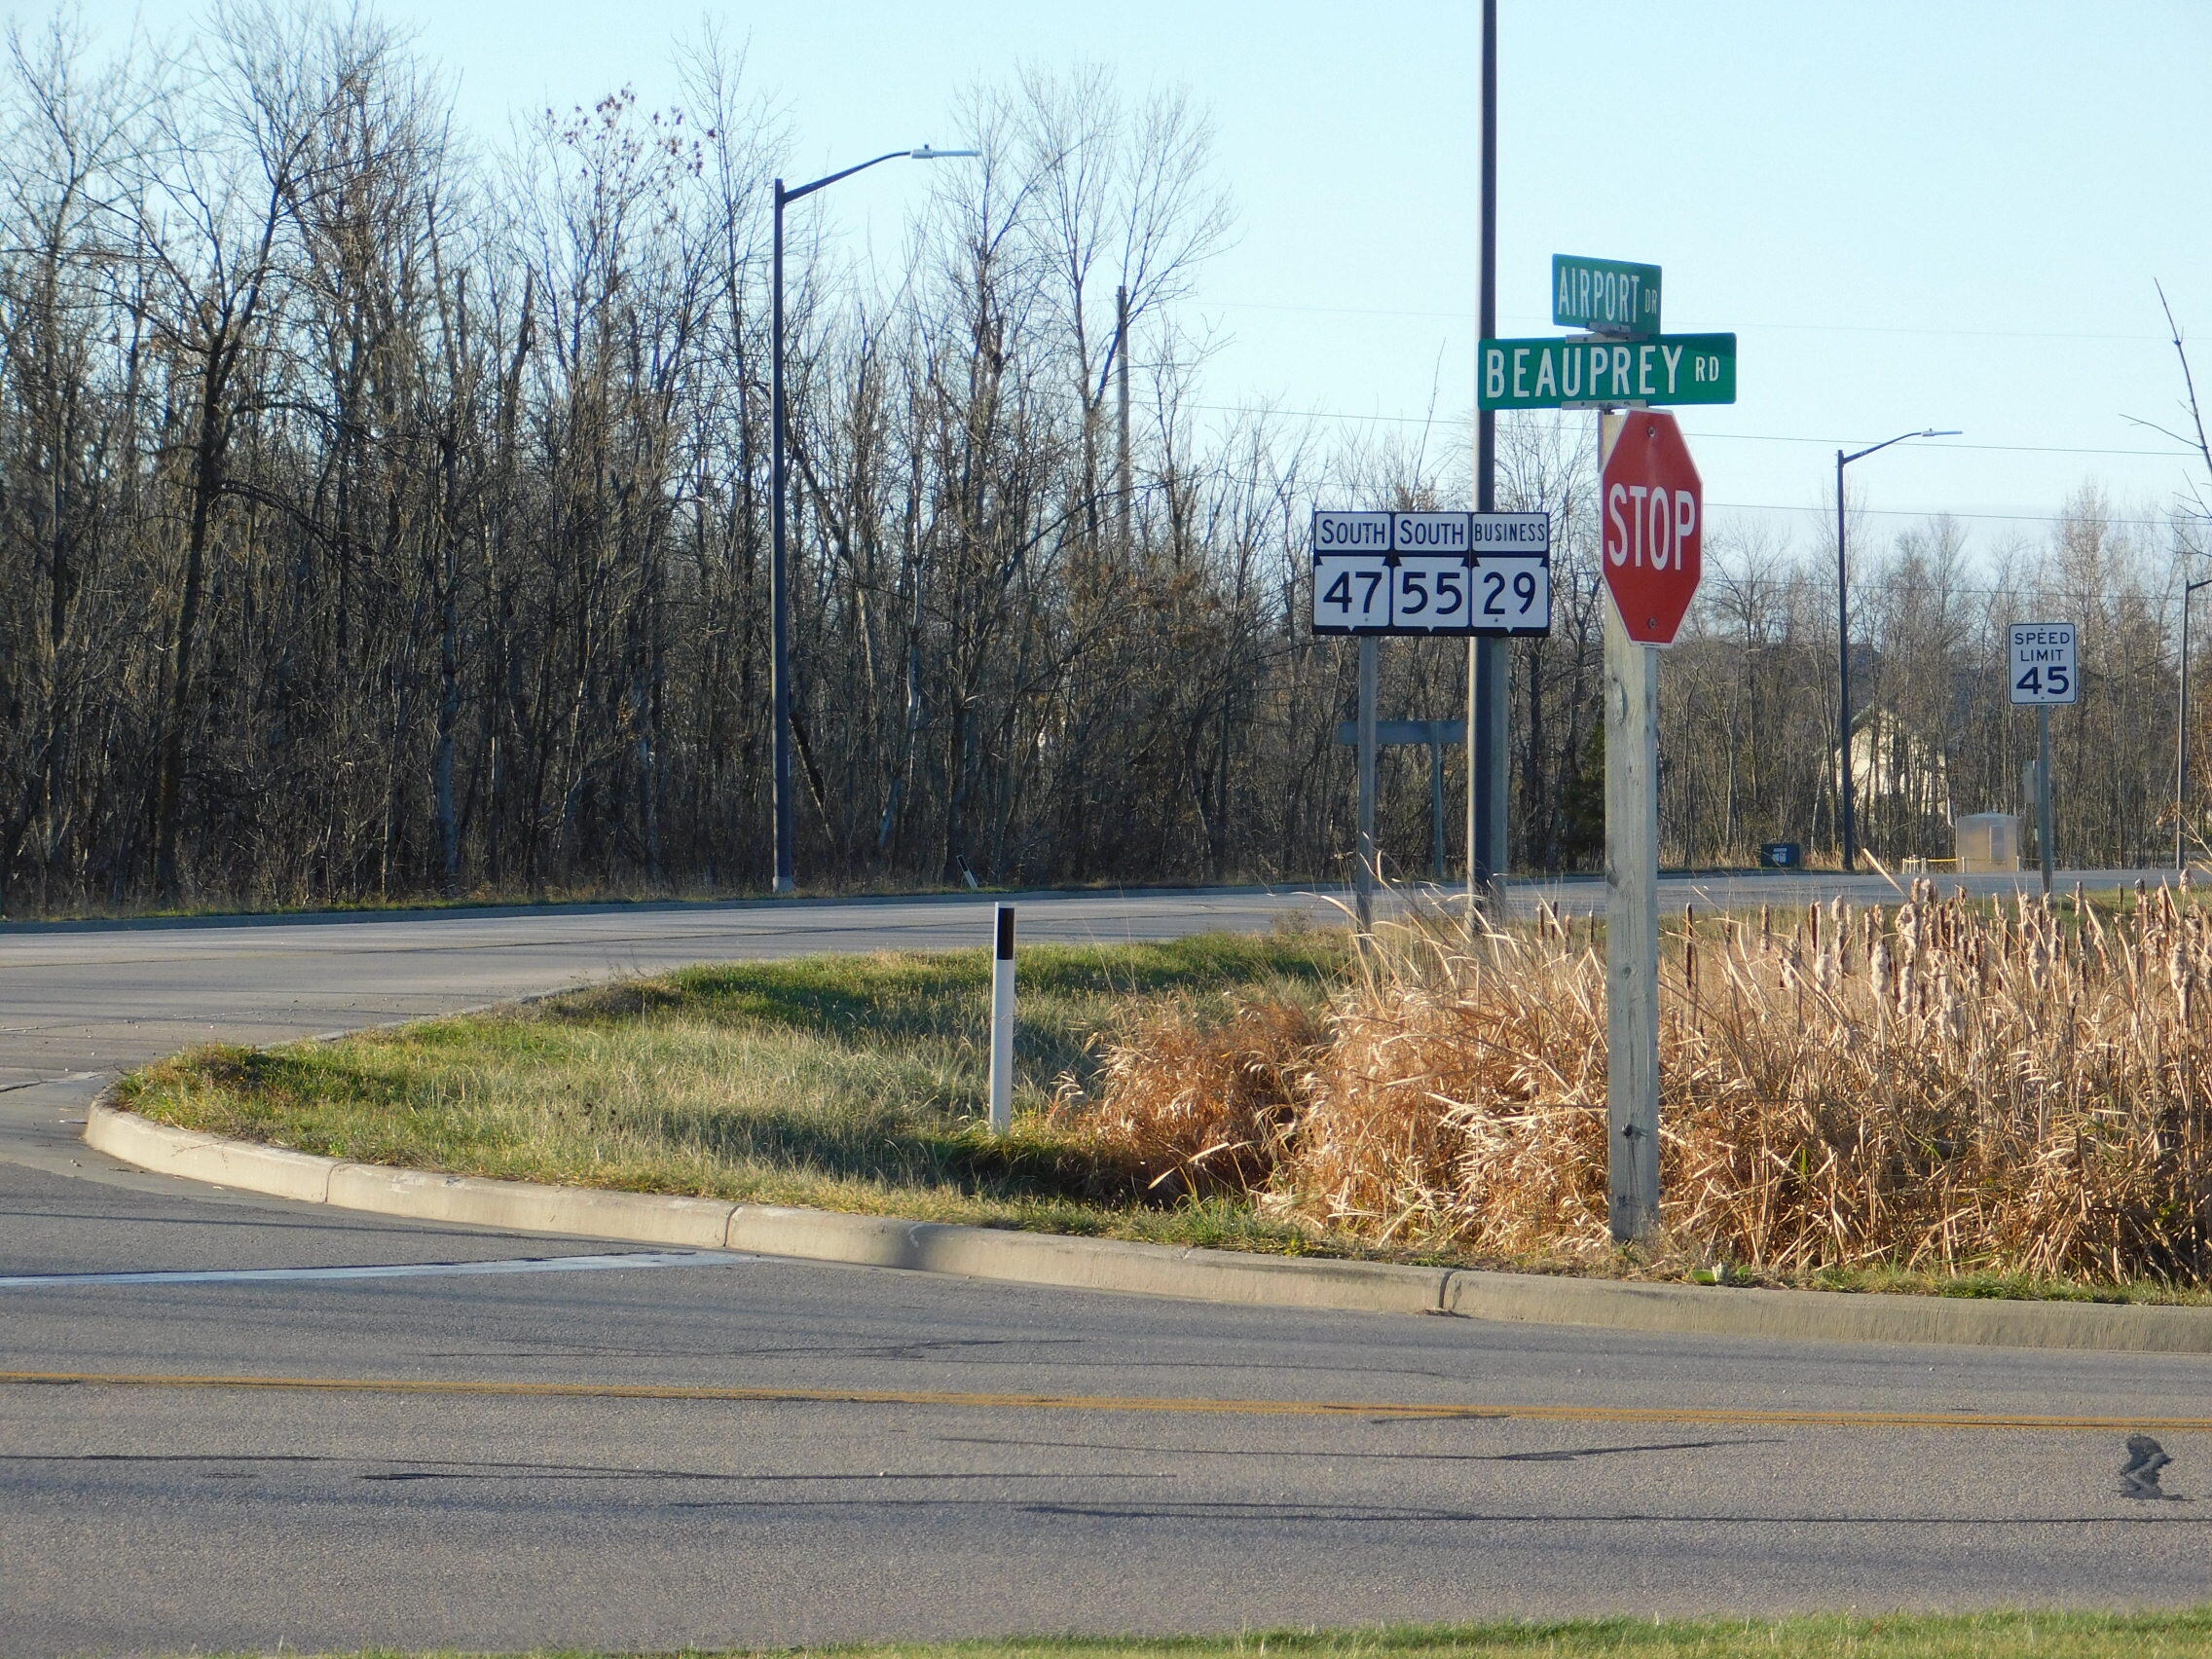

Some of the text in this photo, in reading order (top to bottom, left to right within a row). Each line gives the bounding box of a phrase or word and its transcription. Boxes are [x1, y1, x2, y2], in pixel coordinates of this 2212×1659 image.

[1558, 266, 1657, 323] AIRPORT DR
[1486, 345, 1719, 398] BEAUPREY RD
[1321, 519, 1385, 544] SOUTH
[1400, 519, 1464, 545] SOUTH
[1474, 523, 1545, 541] BUSINESS
[1608, 483, 1695, 571] STOP
[1323, 571, 1382, 613] 47
[1401, 571, 1462, 614] 55
[1483, 571, 1536, 614] 29
[2014, 632, 2070, 645] SPEED
[2020, 648, 2064, 662] LIMIT
[2016, 666, 2070, 695] 45
